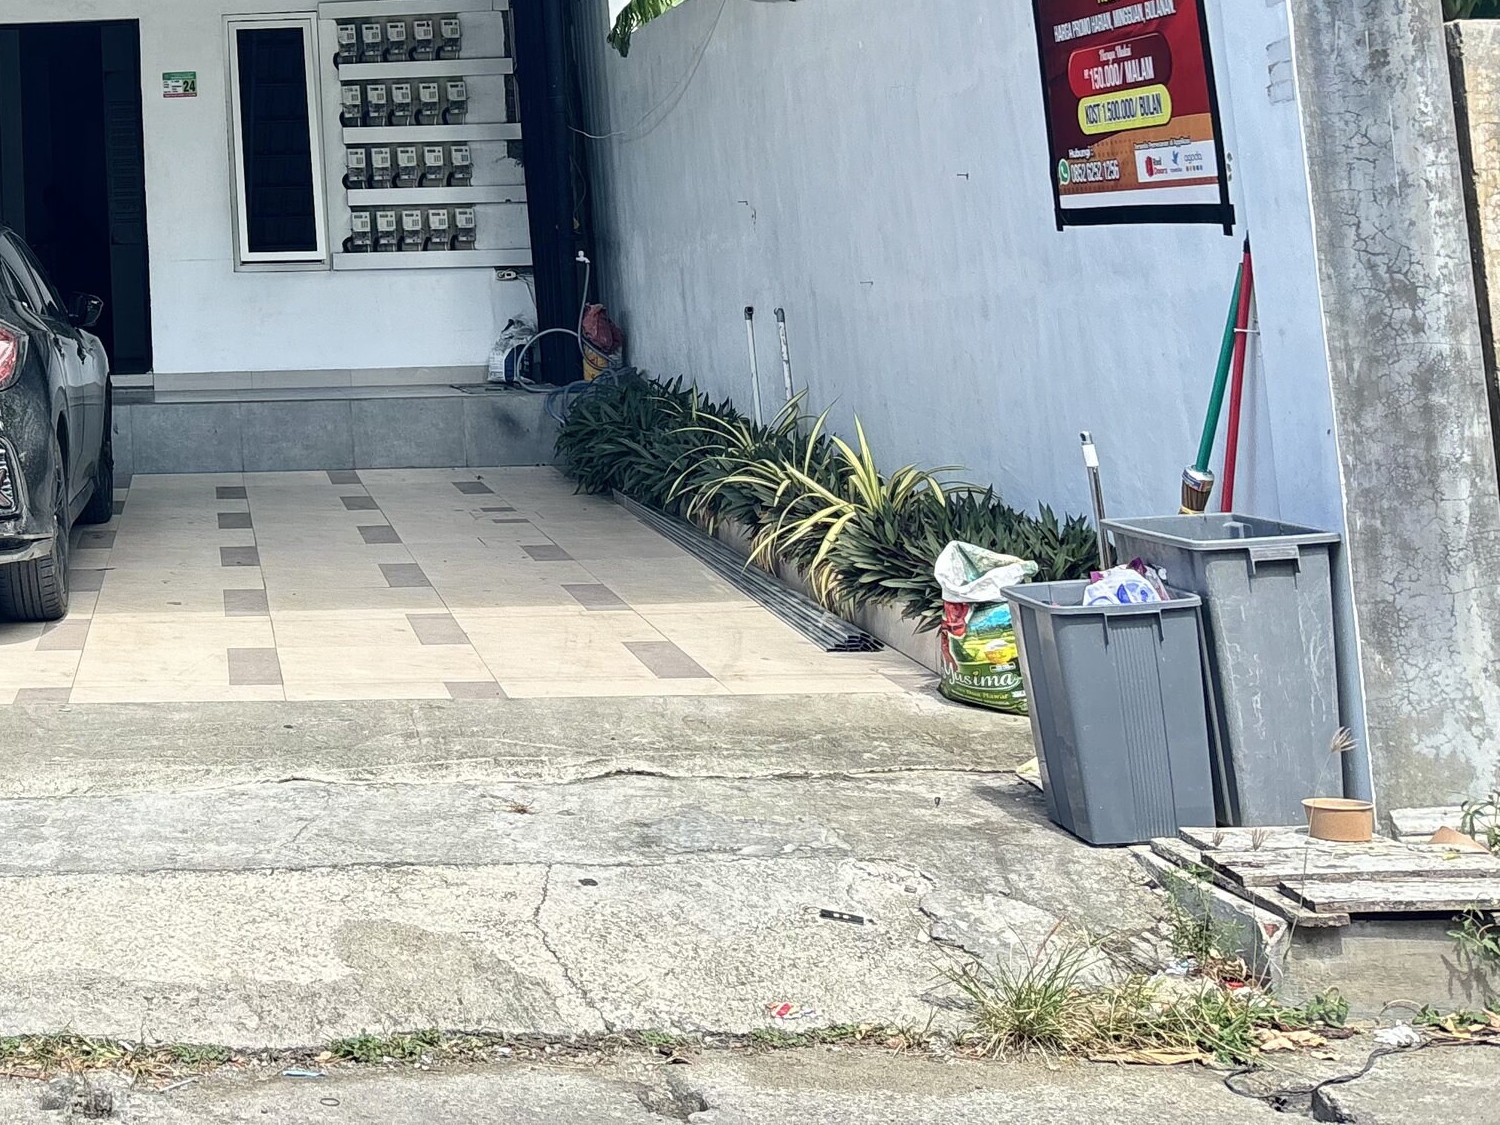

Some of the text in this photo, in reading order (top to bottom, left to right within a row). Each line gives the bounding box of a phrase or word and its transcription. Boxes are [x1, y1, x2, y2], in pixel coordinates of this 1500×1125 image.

[1124, 56, 1154, 83] MALAM
[183, 80, 196, 92] 24
[1085, 102, 1101, 124] KOST
[1139, 93, 1163, 117] BULAN
[1070, 162, 1086, 183] 0852
[1087, 161, 1103, 181] 6252
